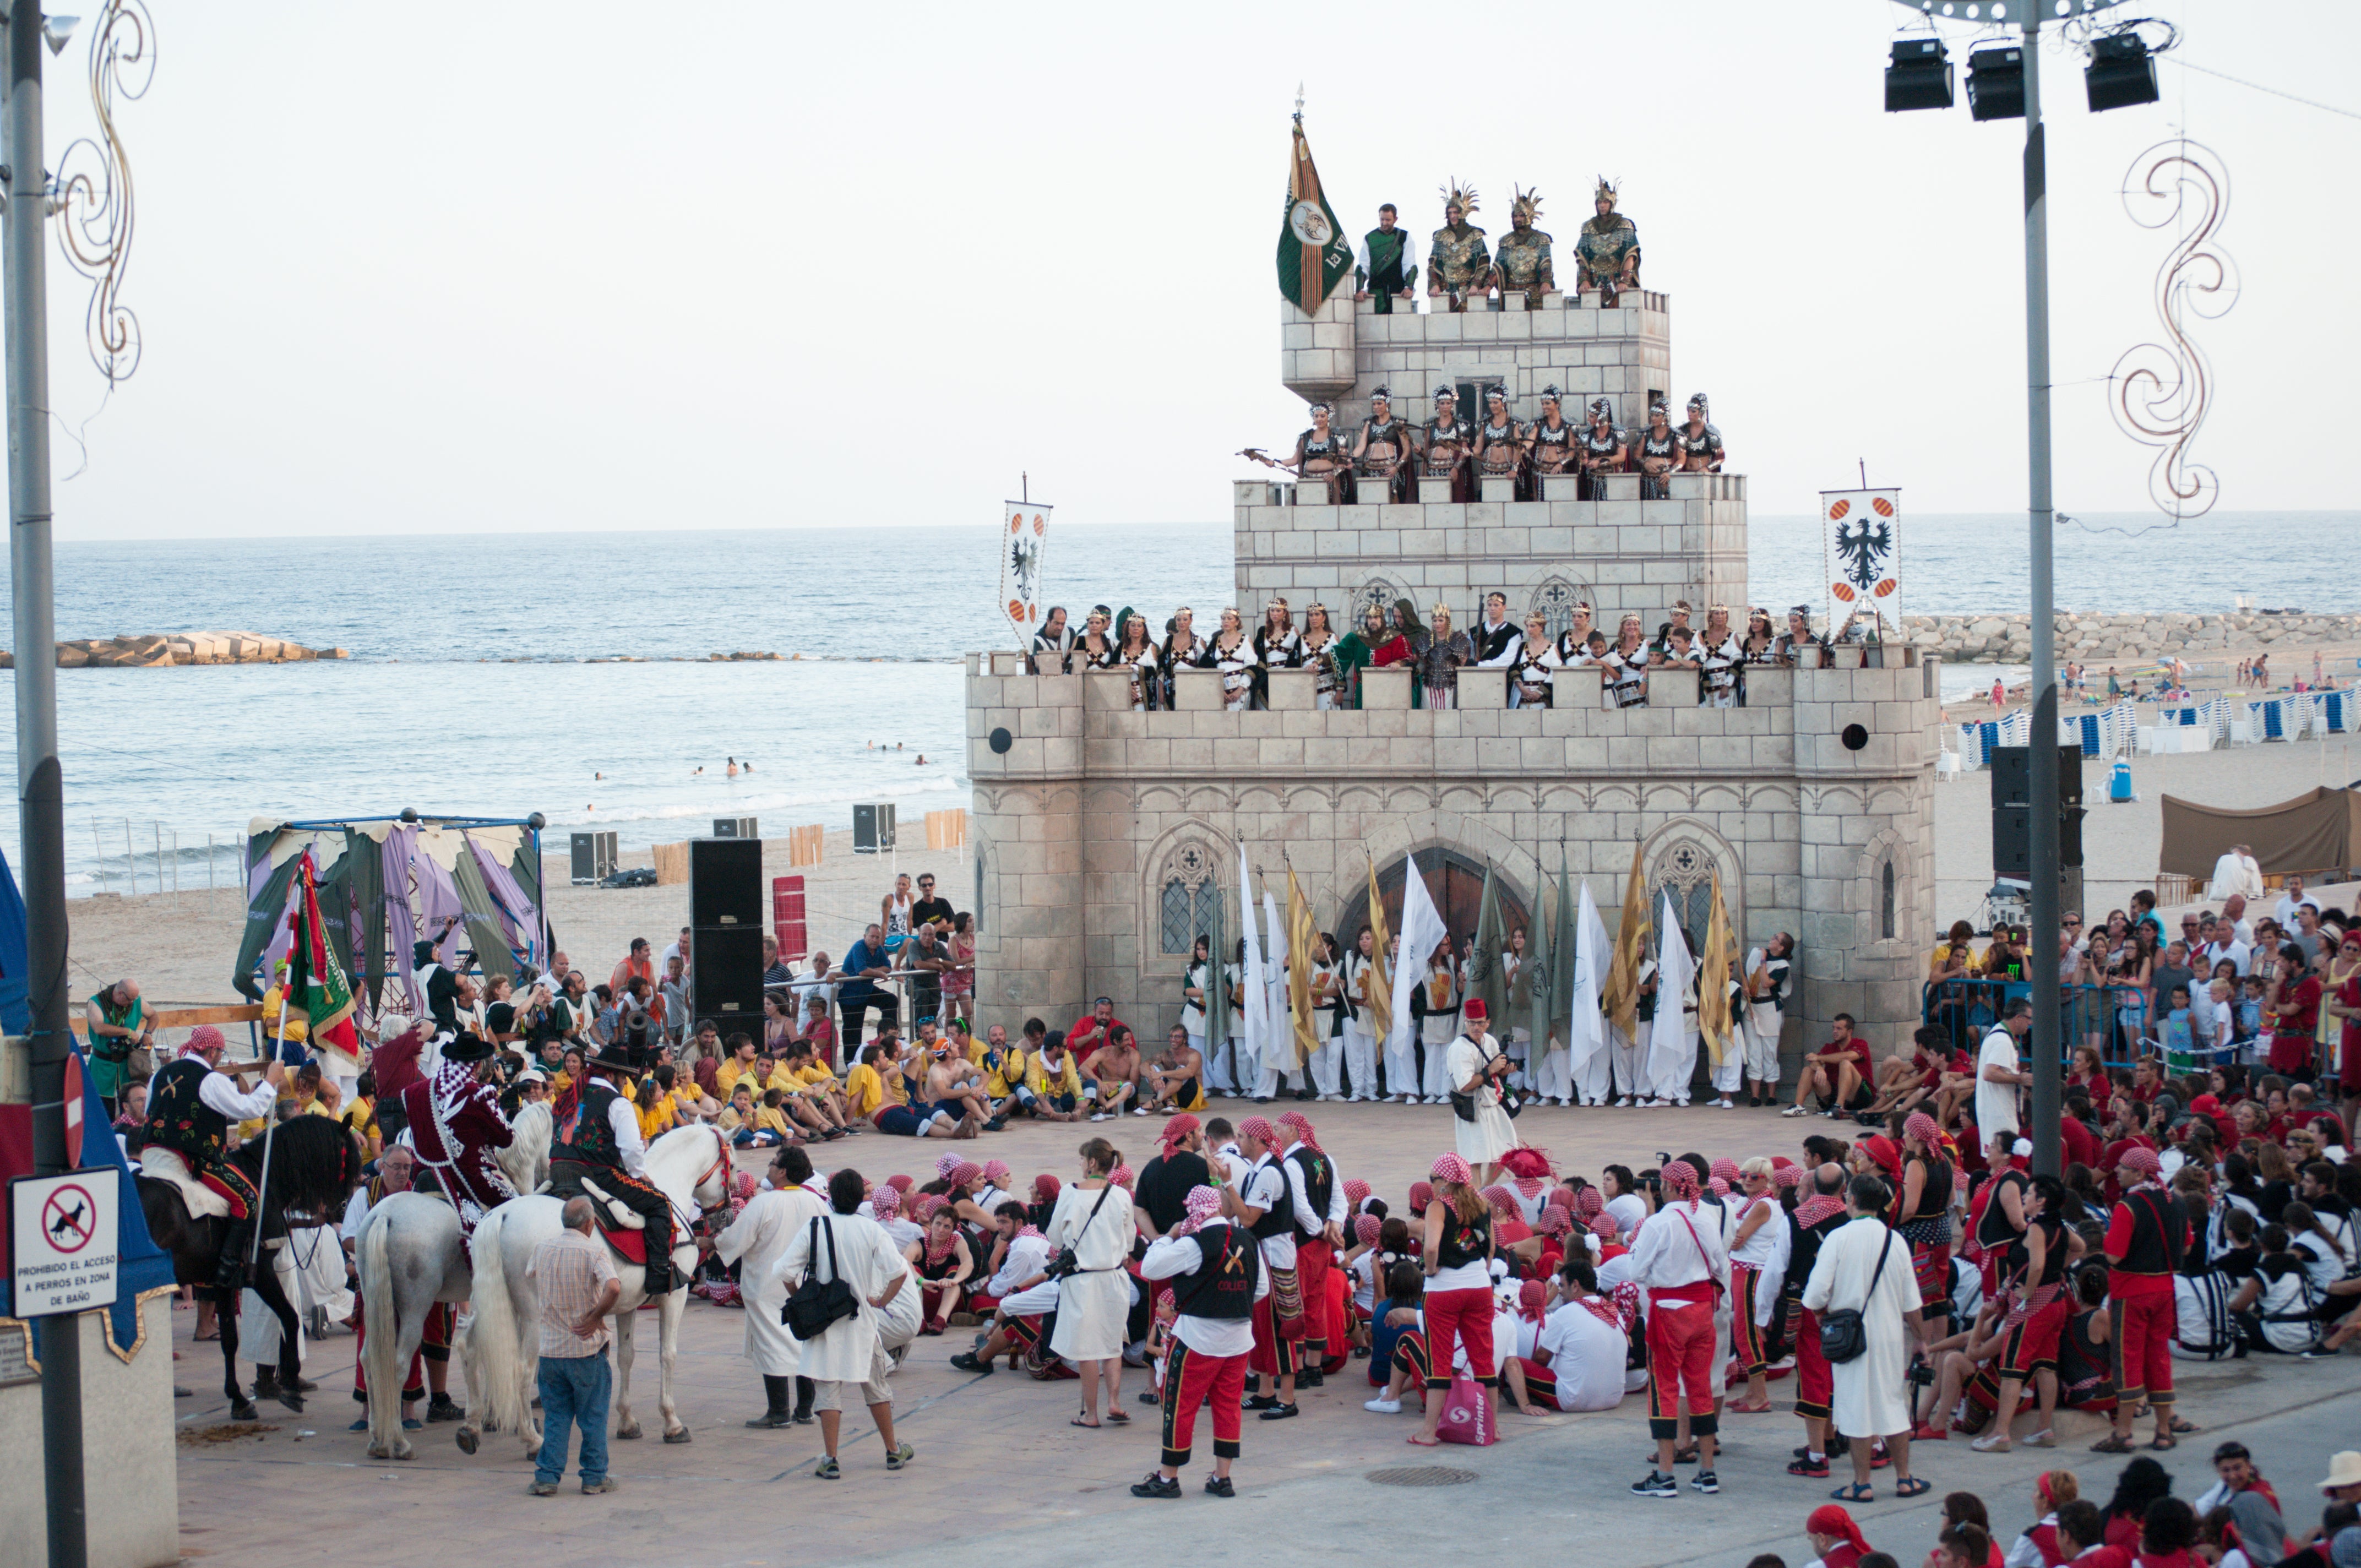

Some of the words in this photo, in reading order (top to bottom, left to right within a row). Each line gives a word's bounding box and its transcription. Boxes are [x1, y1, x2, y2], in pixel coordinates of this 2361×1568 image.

[18, 1262, 67, 1277] PROHIBIDO
[70, 1261, 80, 1270] EL
[84, 1254, 116, 1268] ACCESO
[25, 1283, 31, 1292] A
[35, 1278, 72, 1291] PERROS
[75, 1276, 86, 1286] EN
[90, 1271, 110, 1284] ZONA
[51, 1295, 63, 1306] DE
[66, 1291, 90, 1304] BAÑO
